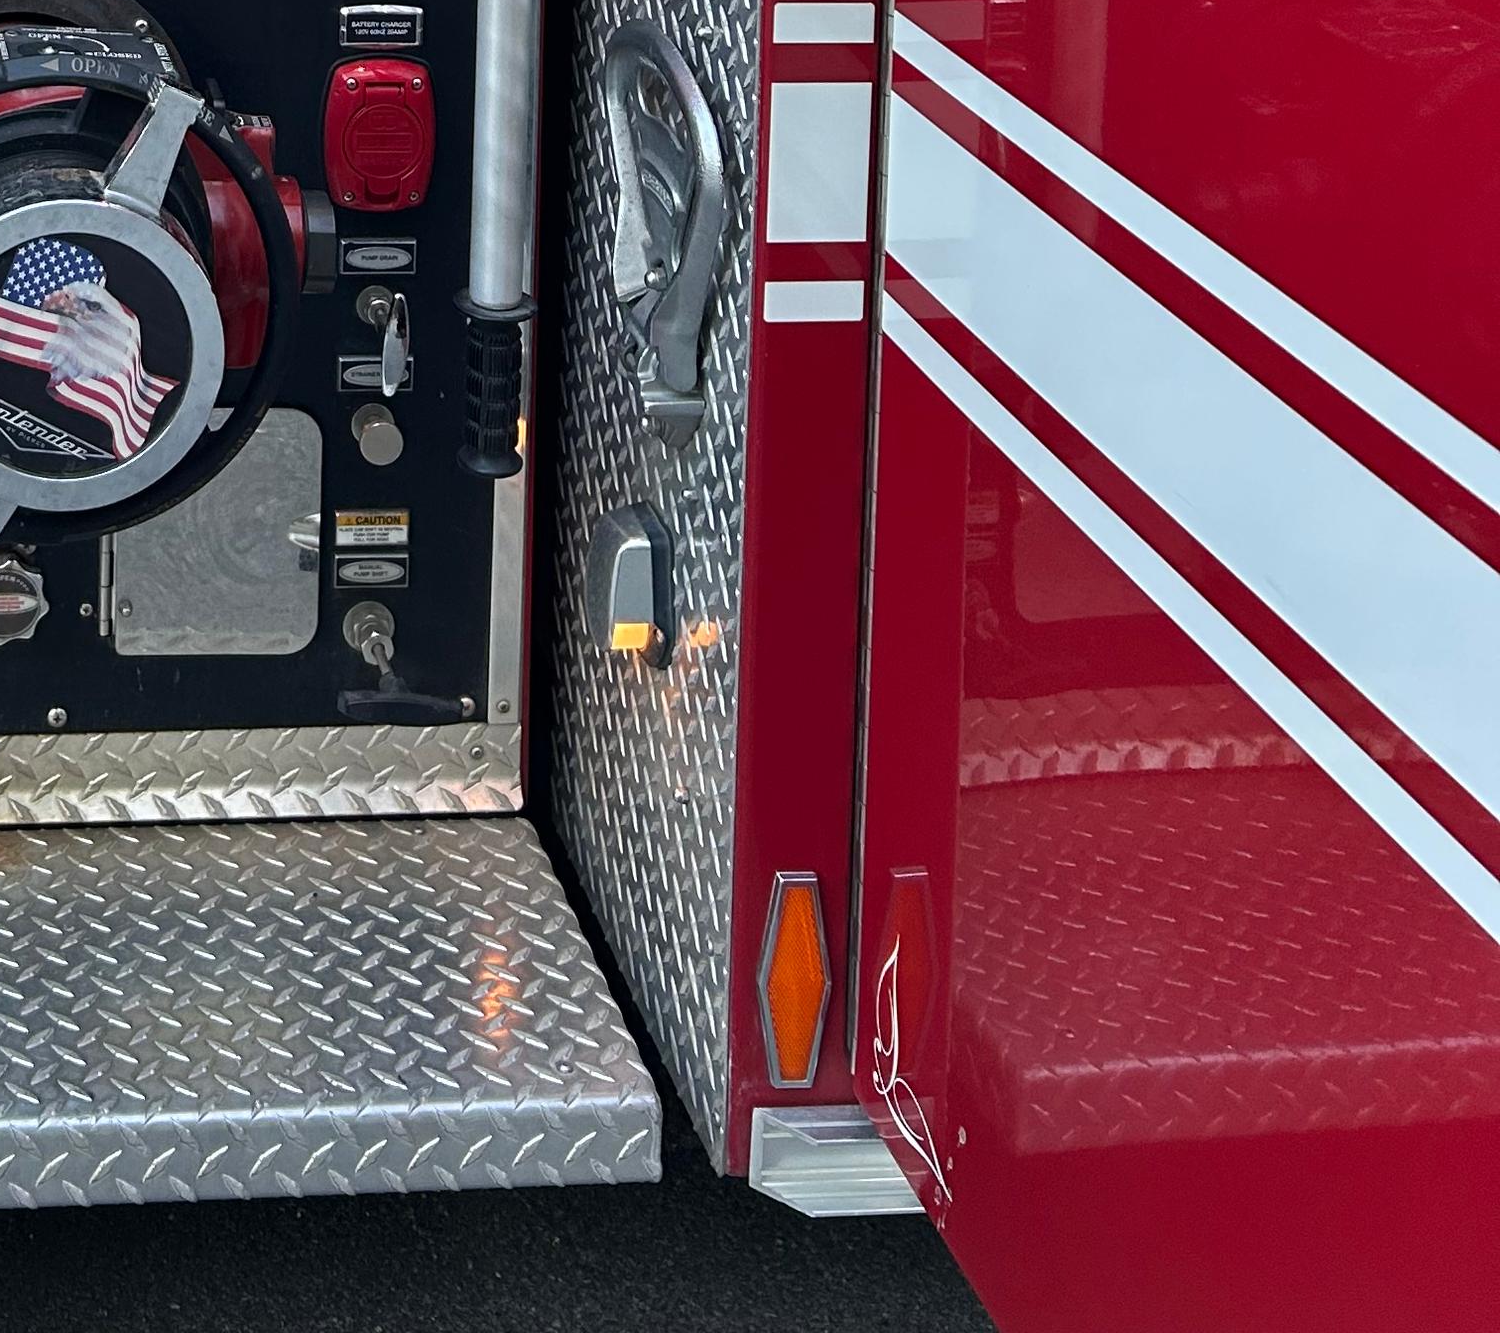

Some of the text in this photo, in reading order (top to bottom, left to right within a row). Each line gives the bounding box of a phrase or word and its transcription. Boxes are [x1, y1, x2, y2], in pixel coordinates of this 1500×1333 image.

[27, 32, 61, 40] OPEN
[93, 51, 142, 59] CLOSED
[71, 57, 122, 79] OPEN
[356, 516, 401, 525] CAUTION
